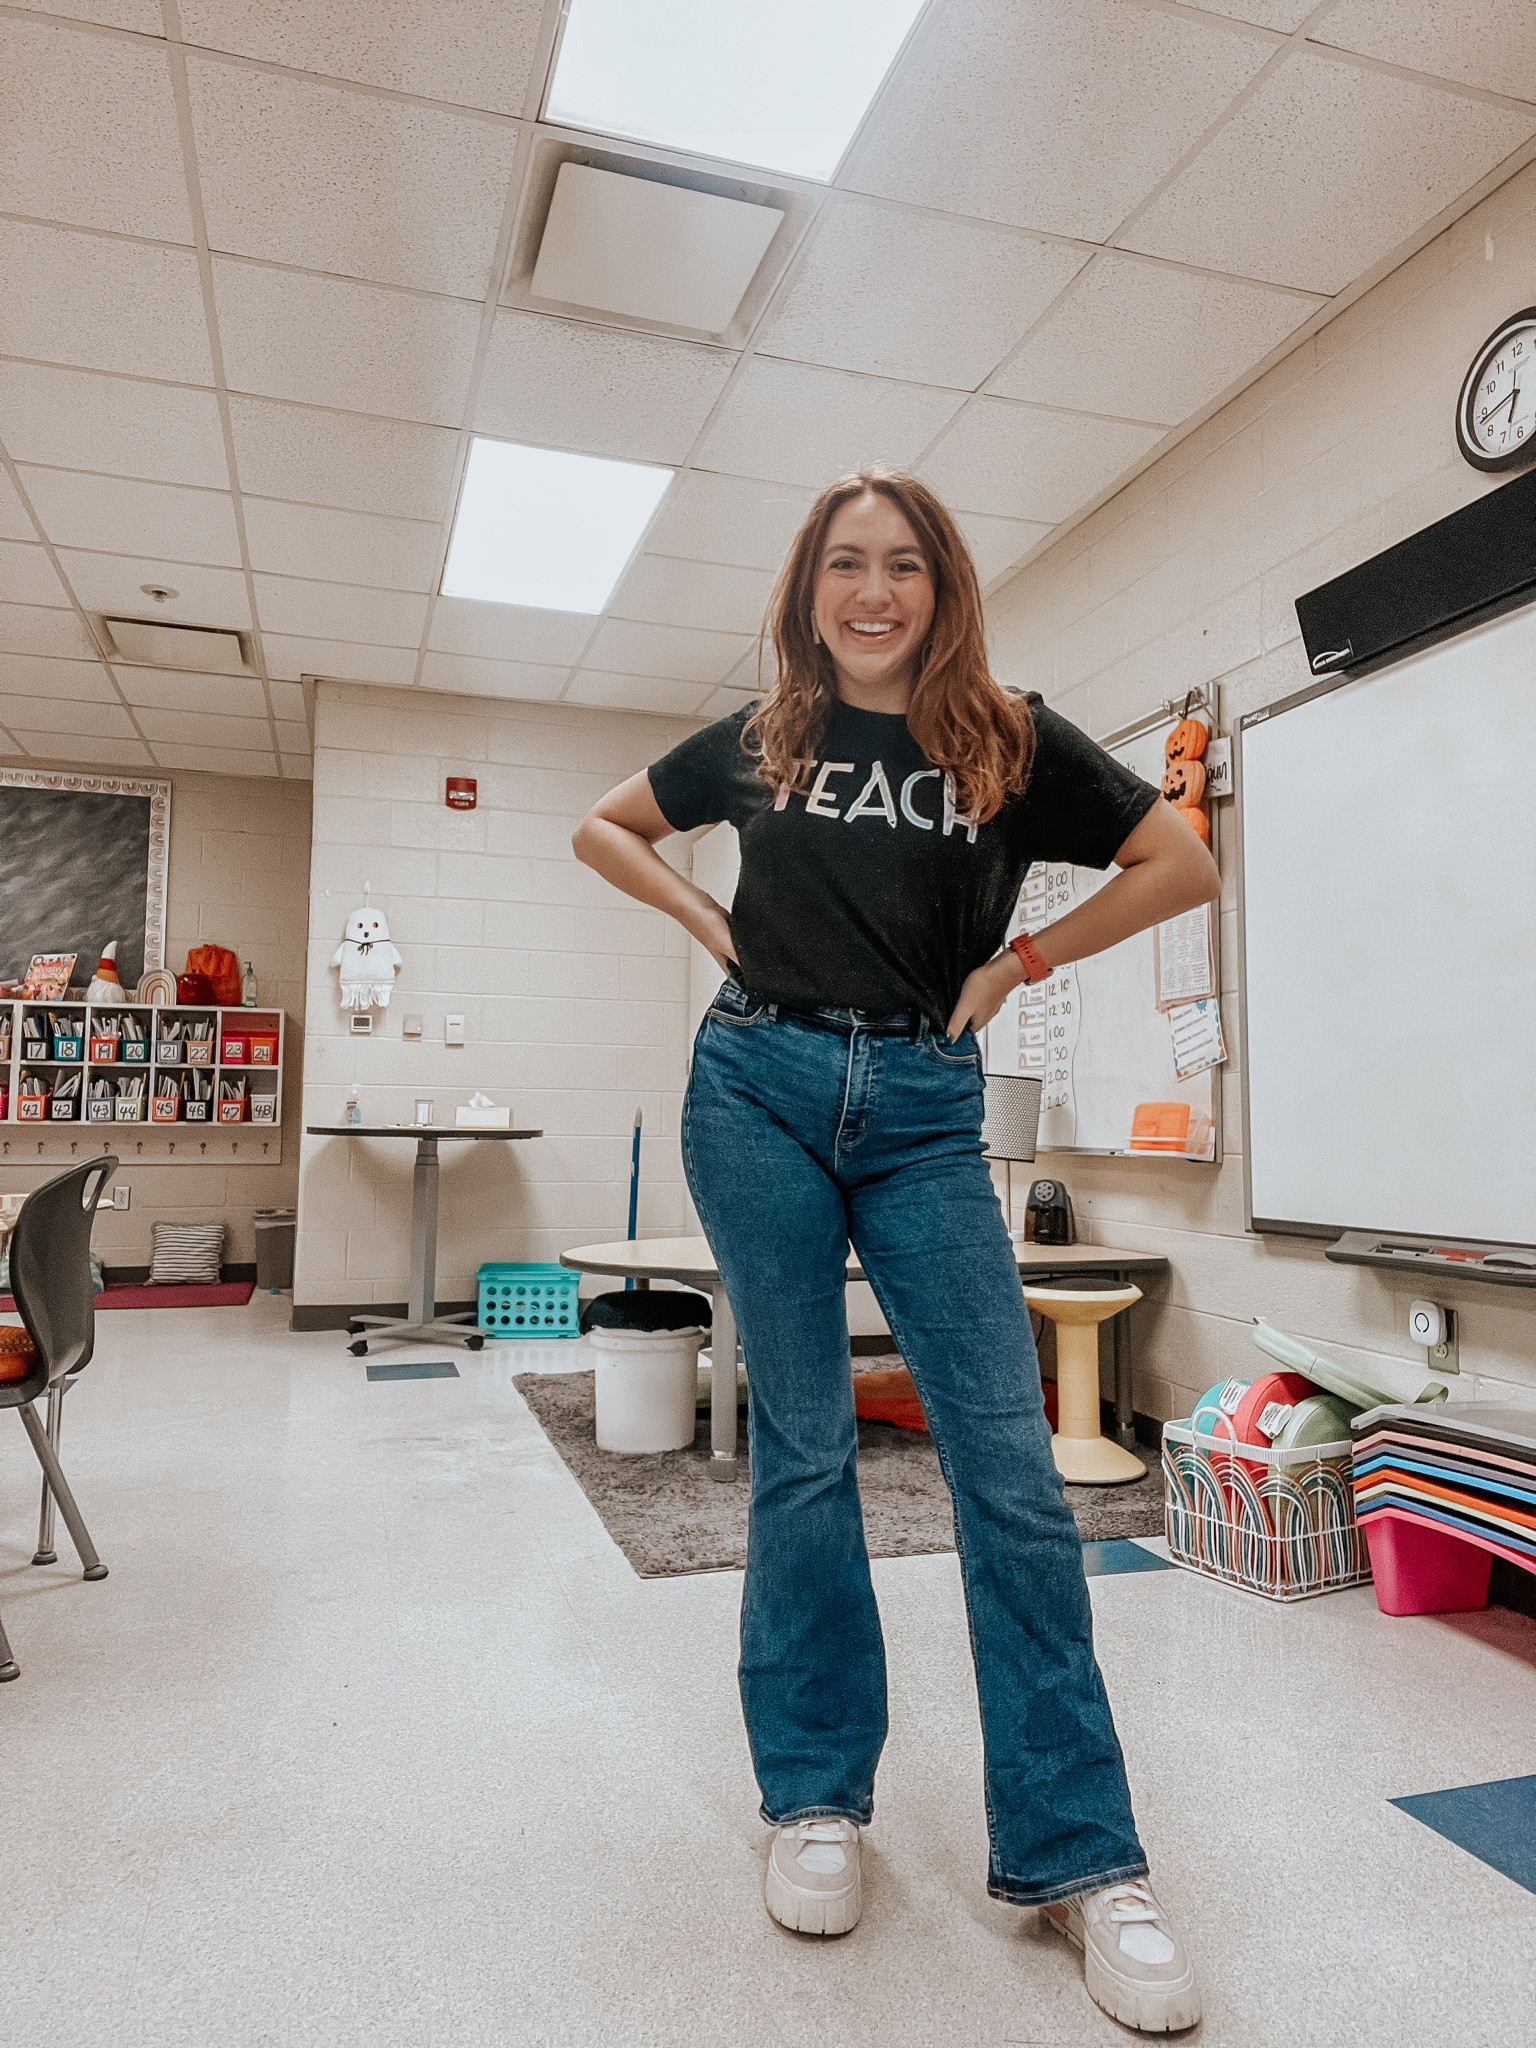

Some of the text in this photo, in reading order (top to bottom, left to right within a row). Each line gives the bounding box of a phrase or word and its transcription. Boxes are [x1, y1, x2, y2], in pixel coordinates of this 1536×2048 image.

[1512, 342, 1523, 358] 12
[1496, 360, 1505, 375] 11
[1486, 381, 1496, 395] 10
[1481, 407, 1488, 420] 9
[1487, 425, 1494, 437] 8
[1500, 431, 1507, 444] 7
[1517, 426, 1524, 439] 6
[30, 1043, 43, 1057] 17
[61, 1042, 75, 1057] 18
[98, 1044, 111, 1059] 19
[126, 1045, 143, 1058] 20
[163, 1046, 175, 1058] 21
[191, 1048, 208, 1060] 22
[226, 1044, 242, 1055] 23
[254, 1047, 269, 1059] 24
[22, 1103, 39, 1116] 41
[54, 1103, 71, 1116] 42
[92, 1103, 109, 1117] 43
[119, 1105, 136, 1117] 44
[157, 1101, 173, 1115] 45
[188, 1104, 204, 1117] 46
[222, 1107, 240, 1119] 47
[255, 1104, 272, 1116] 48
